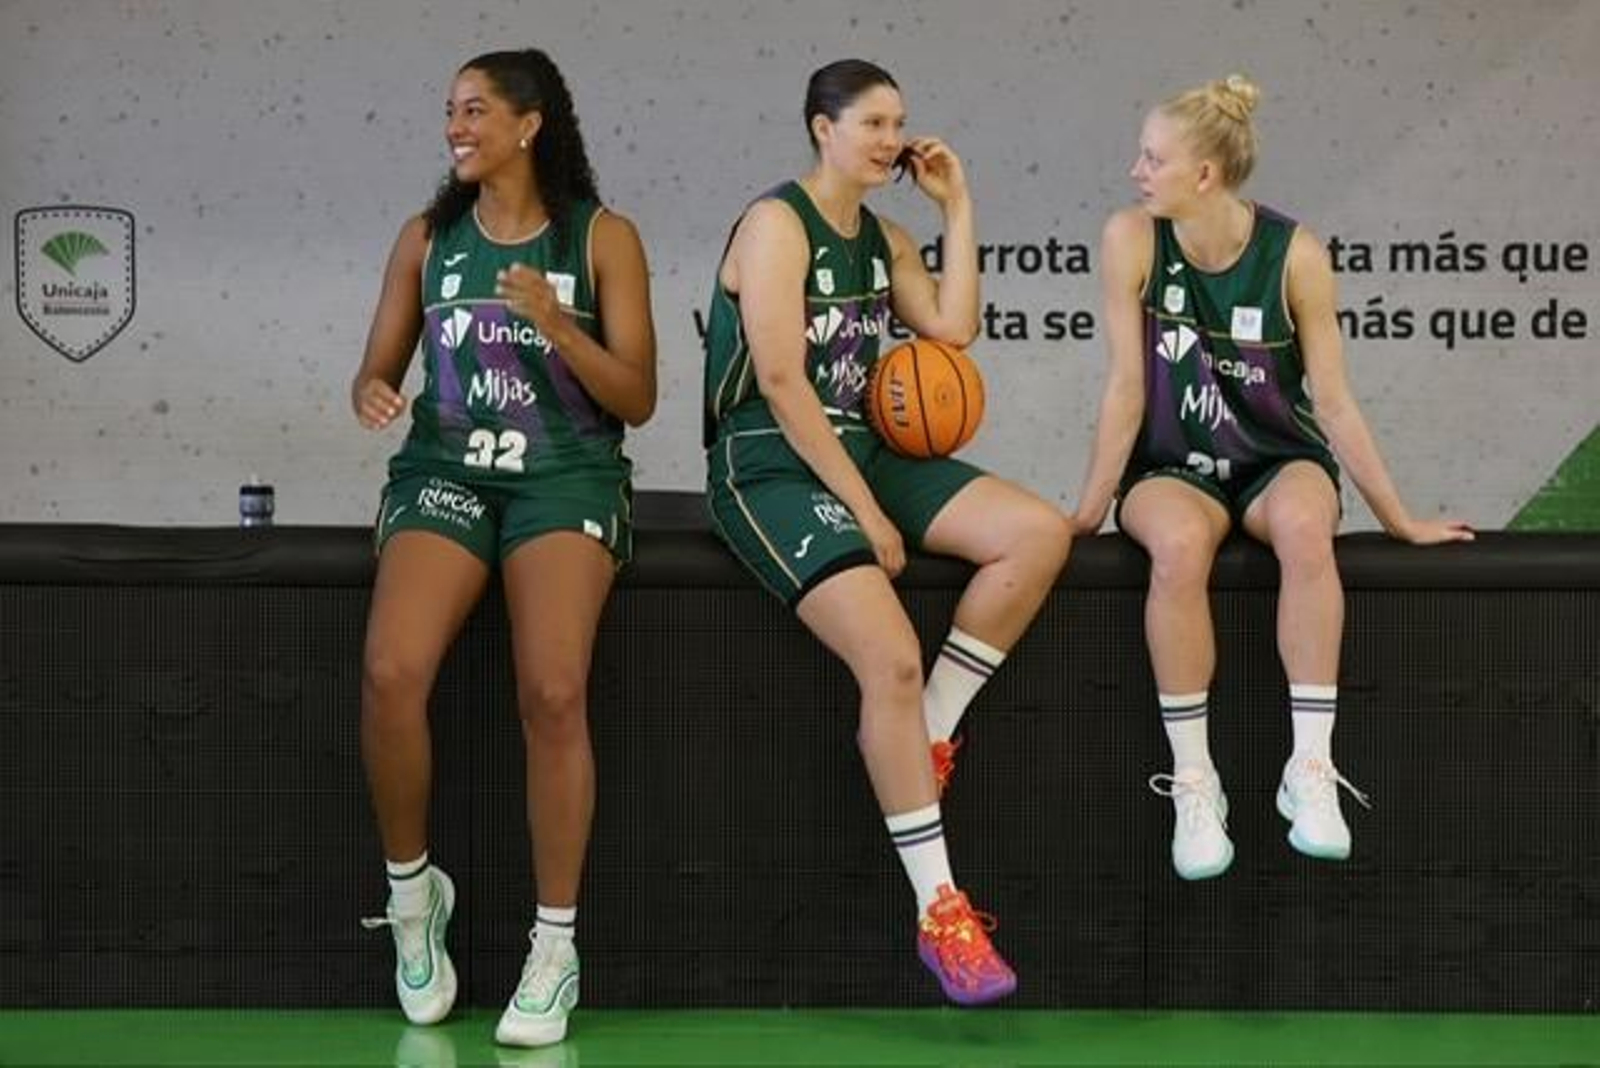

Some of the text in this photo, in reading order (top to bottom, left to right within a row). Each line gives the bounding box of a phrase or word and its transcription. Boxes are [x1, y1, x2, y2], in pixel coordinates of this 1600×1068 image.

[919, 236, 1090, 274] drrota
[1389, 231, 1487, 272] más
[1502, 243, 1588, 283] que
[42, 281, 107, 302] Unicaja
[1043, 312, 1095, 340] se
[1430, 308, 1515, 350] que
[1531, 299, 1587, 339] de
[466, 368, 537, 411] Mijas
[463, 428, 528, 473] 32
